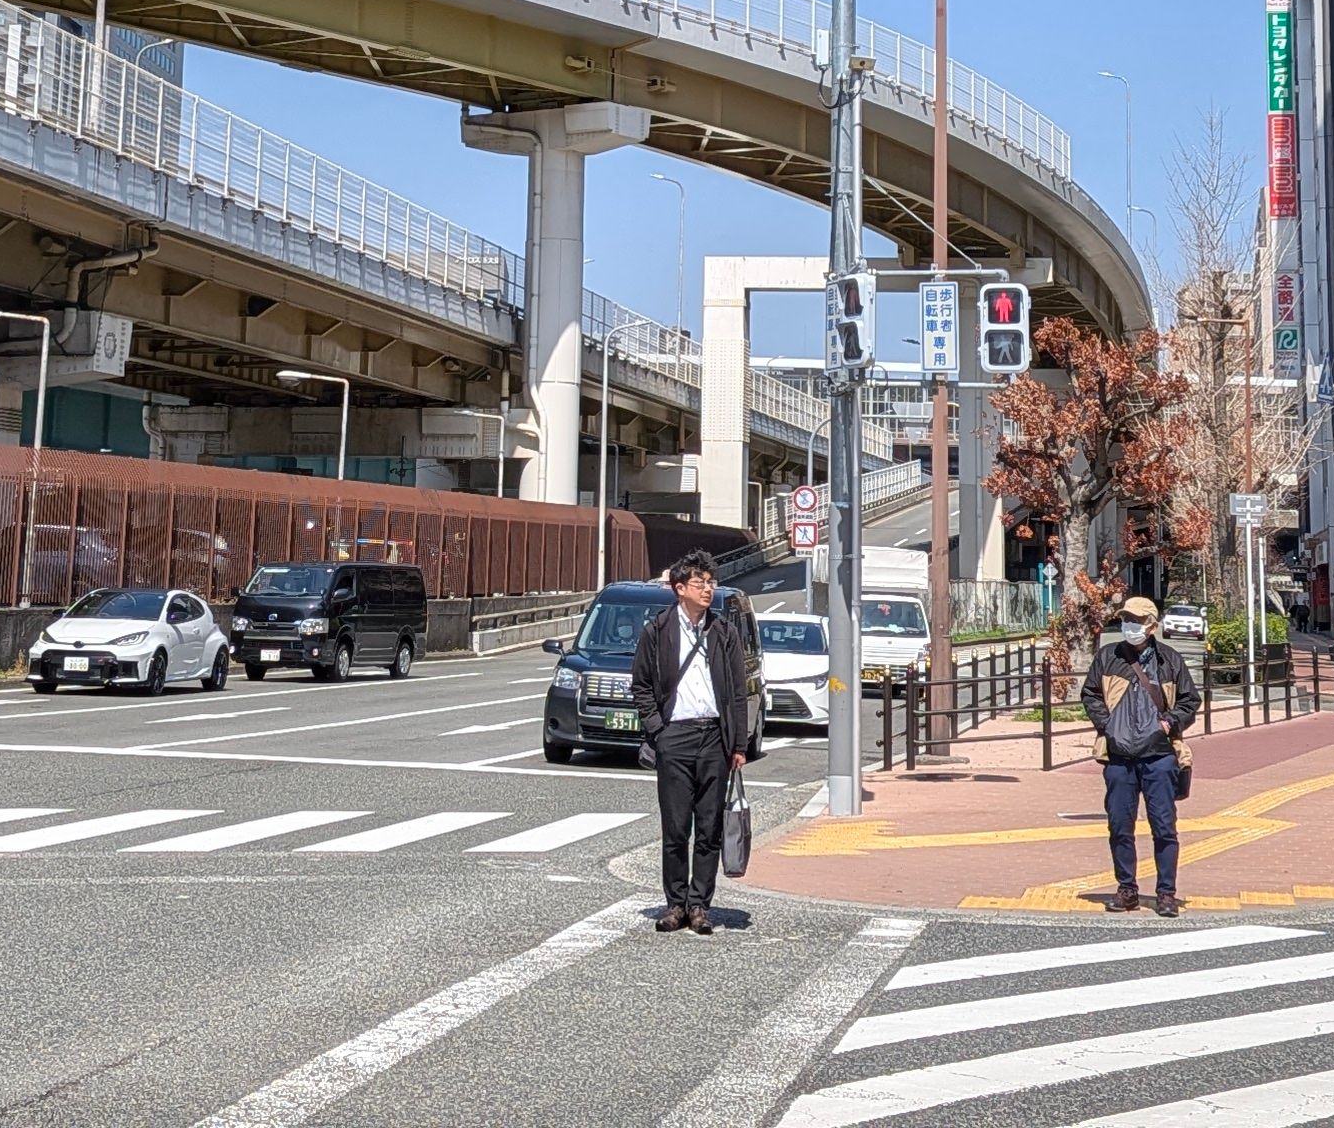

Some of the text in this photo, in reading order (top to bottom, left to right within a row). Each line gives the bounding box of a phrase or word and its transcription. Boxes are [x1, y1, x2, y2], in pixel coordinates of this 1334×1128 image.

[1272, 14, 1289, 109] トヨタレンタカー
[925, 288, 938, 333] 自転車
[940, 288, 953, 332] 歩行者
[933, 336, 946, 366] 専用
